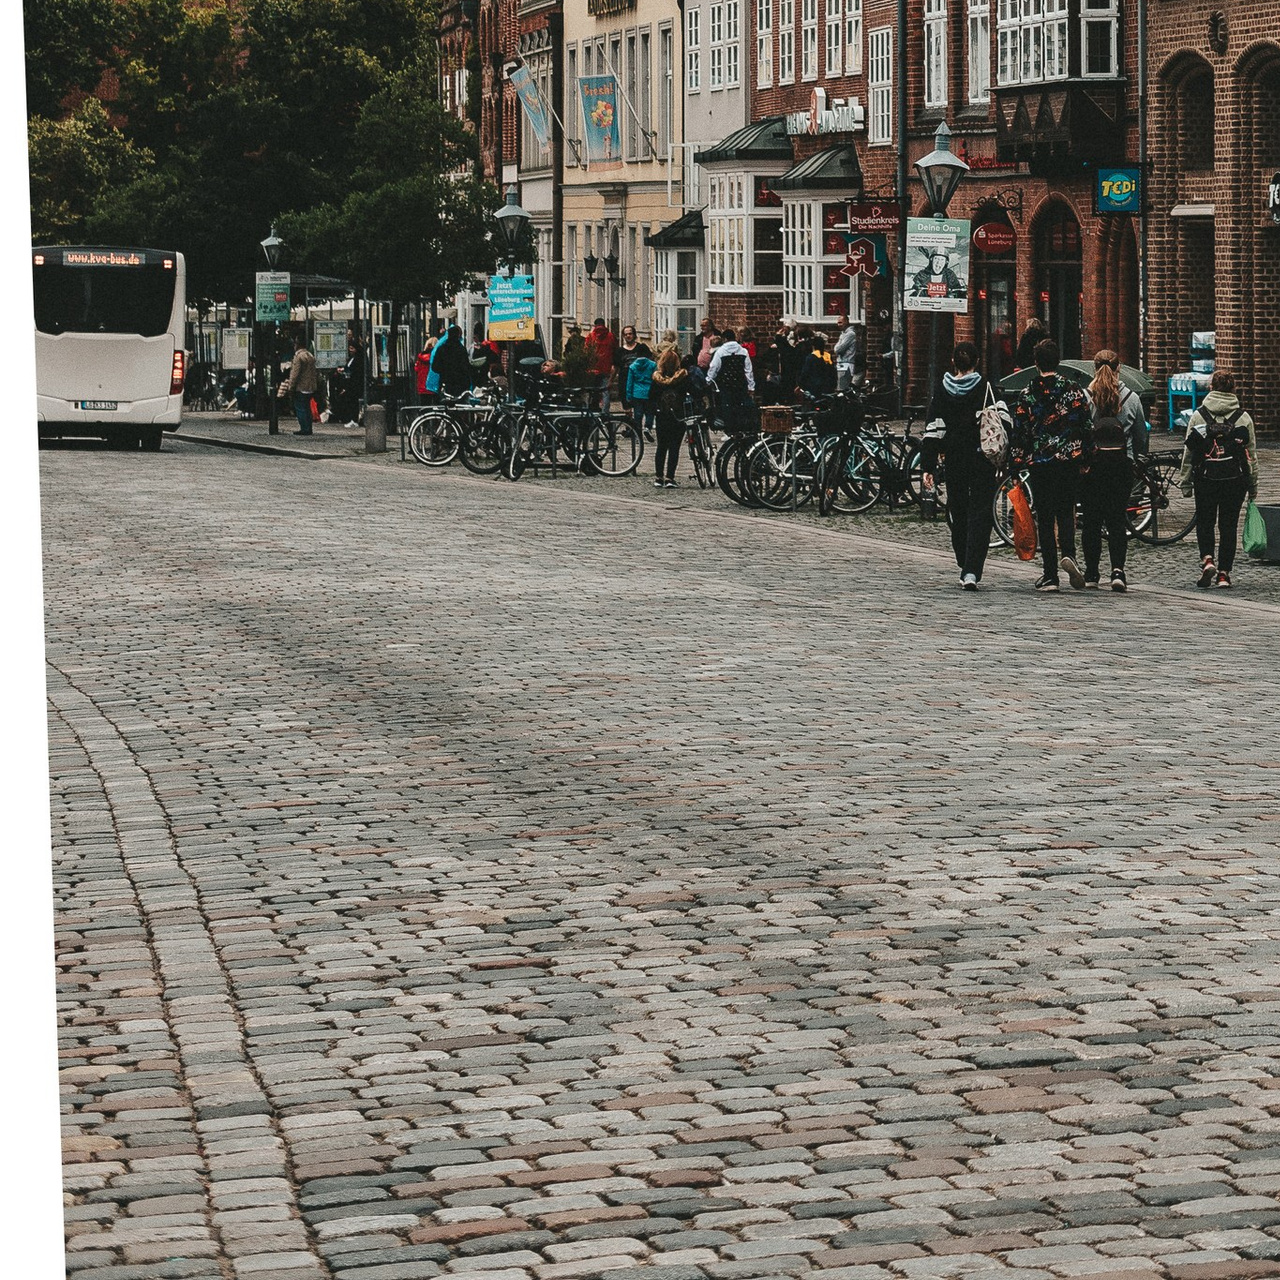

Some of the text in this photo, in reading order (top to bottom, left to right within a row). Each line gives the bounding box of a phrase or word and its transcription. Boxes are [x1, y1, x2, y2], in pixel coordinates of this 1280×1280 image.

[583, 82, 614, 96] Fresh!
[851, 216, 900, 225] Studienkreis
[917, 223, 961, 233] Deine Oma
[928, 283, 946, 291] Jetzt
